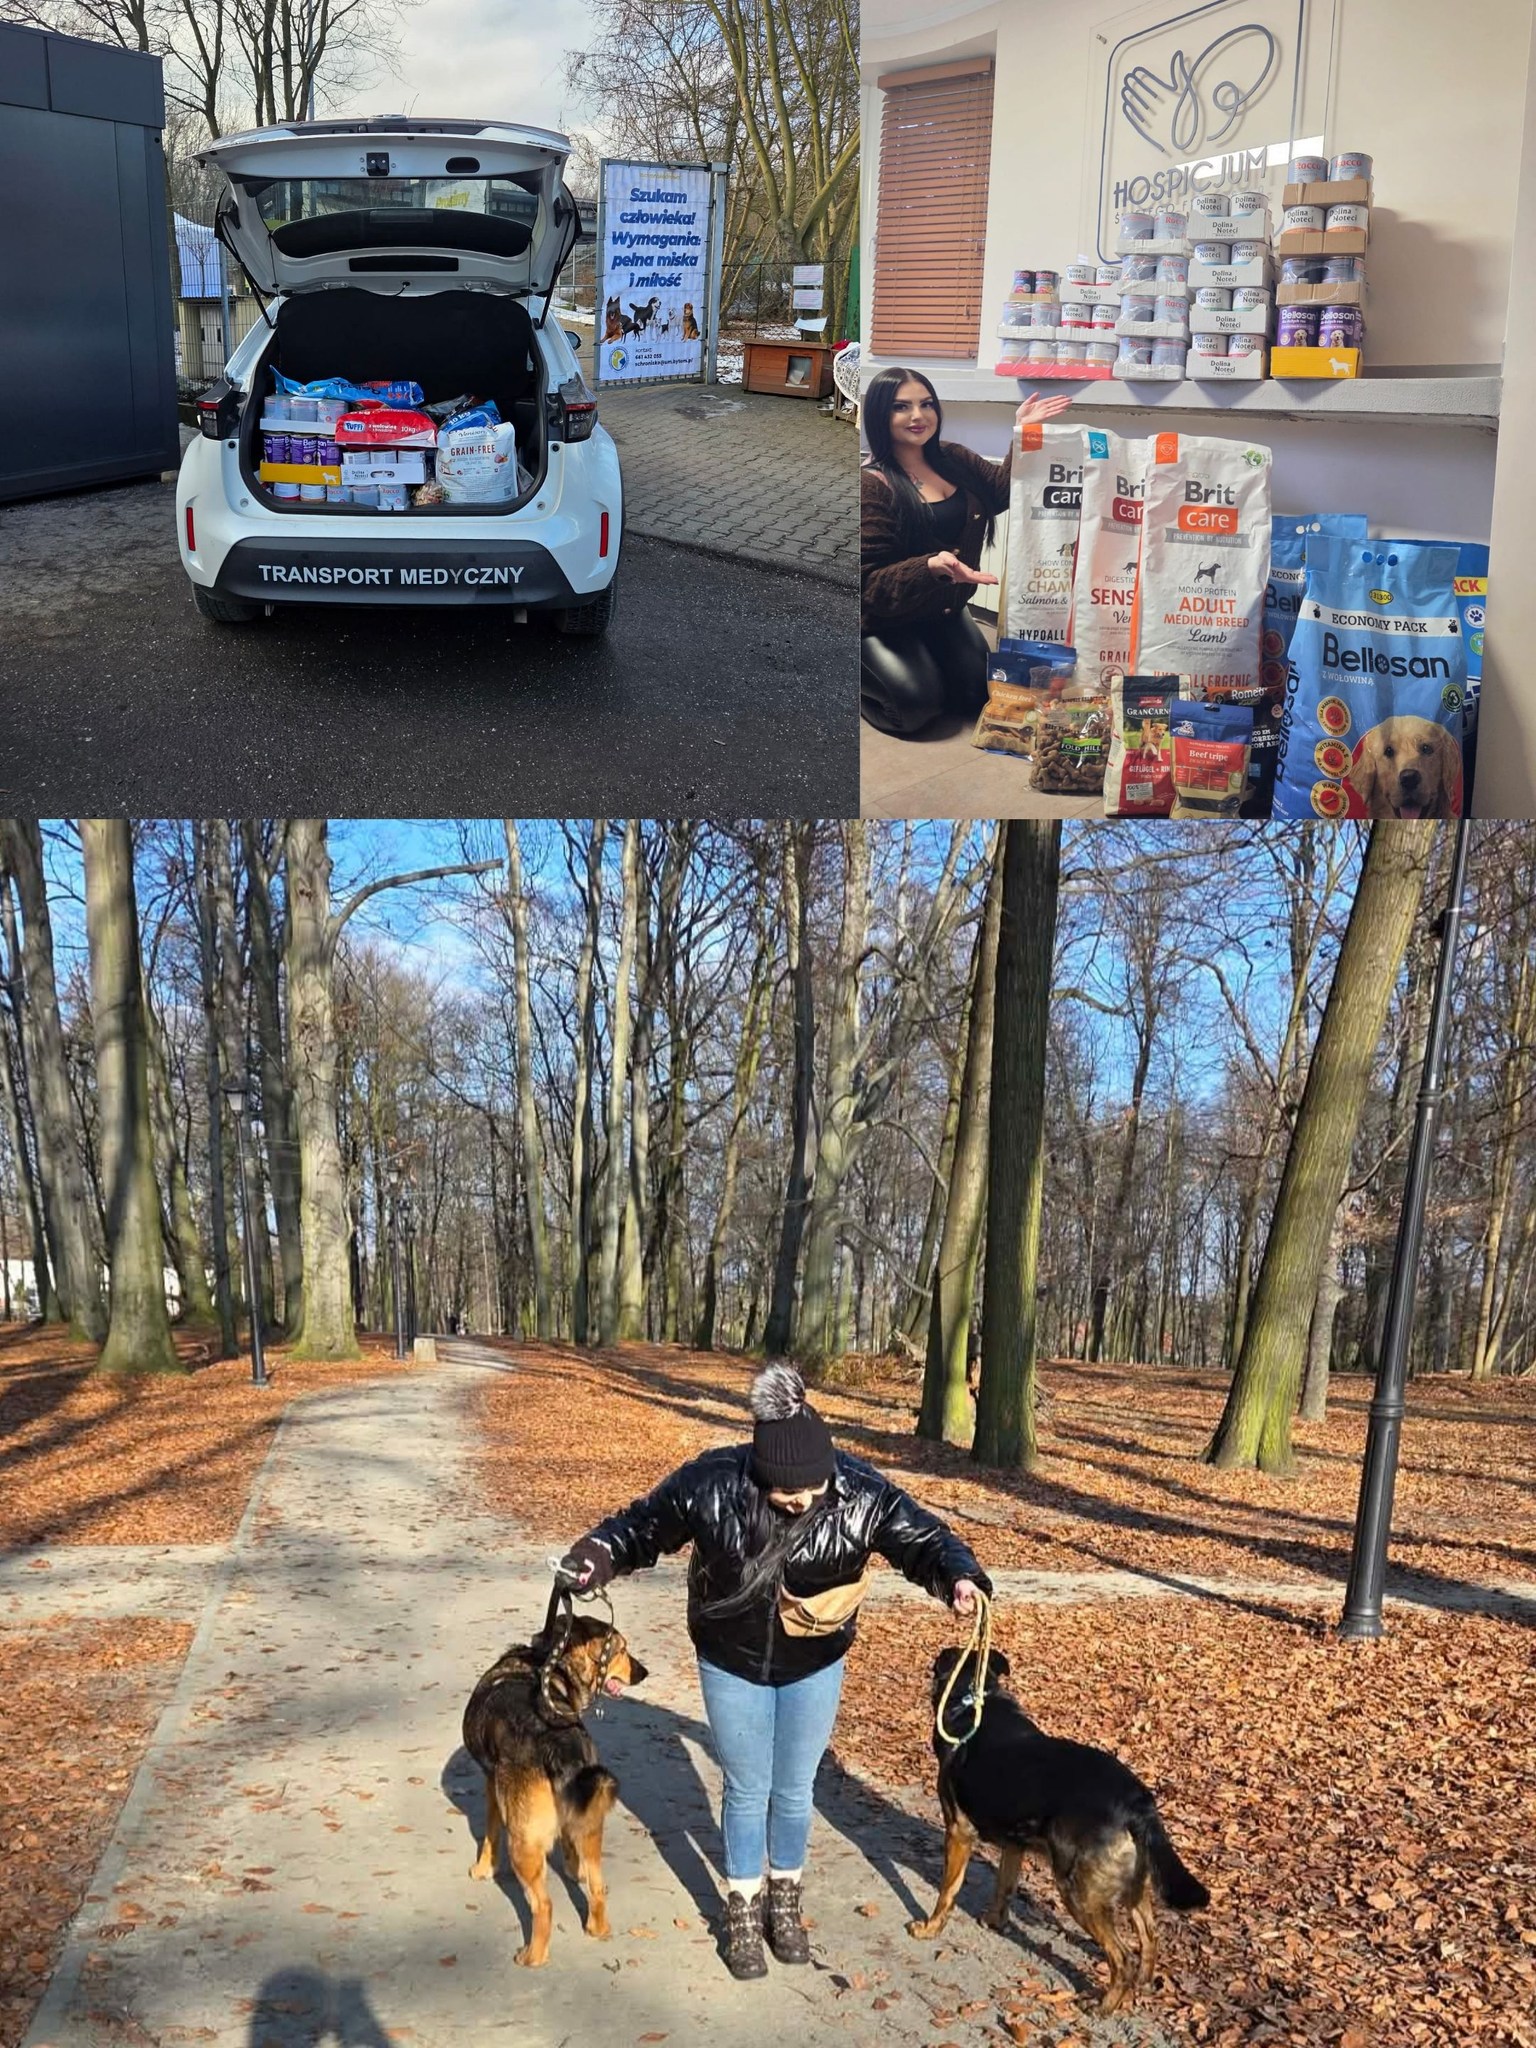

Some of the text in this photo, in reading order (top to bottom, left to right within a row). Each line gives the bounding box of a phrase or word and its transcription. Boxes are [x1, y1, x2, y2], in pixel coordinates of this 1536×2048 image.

[1113, 145, 1268, 209] HOSPICJUM
[630, 187, 687, 204] Szukam
[620, 209, 696, 225] człowieka!
[1287, 210, 1308, 219] Dolina
[1329, 208, 1351, 216] Dolina
[612, 231, 701, 249] Wymagania:
[611, 252, 698, 270] pełna miska
[629, 272, 682, 287] i miłość
[1282, 309, 1316, 320] Bellosan
[1321, 310, 1354, 320] Bellosan
[450, 444, 496, 457] GRAIN-FREE
[1049, 463, 1083, 483] Bri
[1116, 475, 1146, 498] Bri
[1184, 480, 1235, 505] Brit
[1186, 512, 1229, 528] care
[258, 565, 525, 585] TRANSPORT MEDYCZNY
[1033, 568, 1060, 579] DOG
[1018, 594, 1058, 605] Salmon
[1178, 586, 1237, 597] MONO PROTEIN
[1179, 596, 1236, 614] ADULT
[1163, 614, 1250, 628] MEDIUM BREED
[1332, 613, 1428, 633] ECONOMY PACK
[1019, 629, 1065, 641] HYPOALL
[1188, 628, 1227, 644] Lamb
[1323, 632, 1450, 679] Bellosan
[1327, 672, 1374, 687] WOŁOWINĄ
[1189, 750, 1229, 761] Beef tripe
